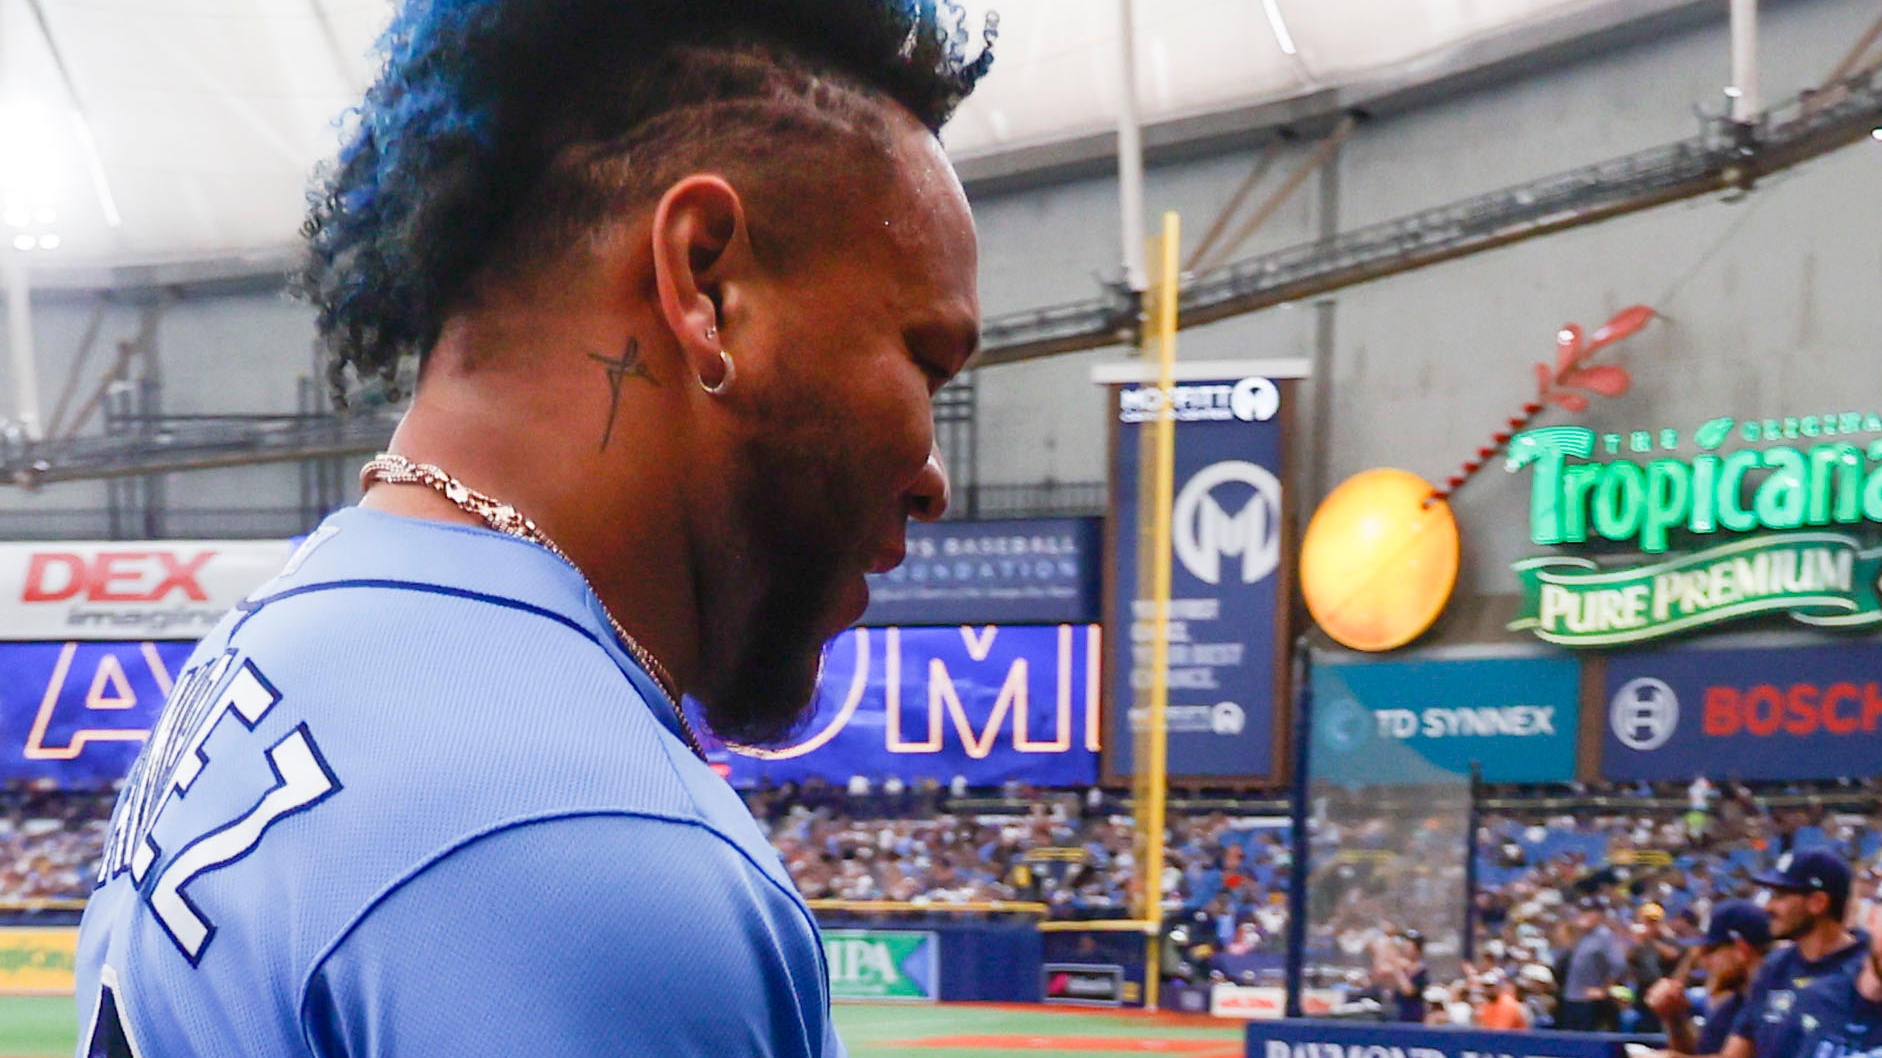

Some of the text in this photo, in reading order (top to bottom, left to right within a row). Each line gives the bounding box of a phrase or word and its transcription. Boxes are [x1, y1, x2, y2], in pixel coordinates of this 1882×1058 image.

[19, 551, 218, 604] DEX
[1540, 547, 1855, 634] PURE PREMIUM
[1375, 703, 1556, 739] TD SYNNEX
